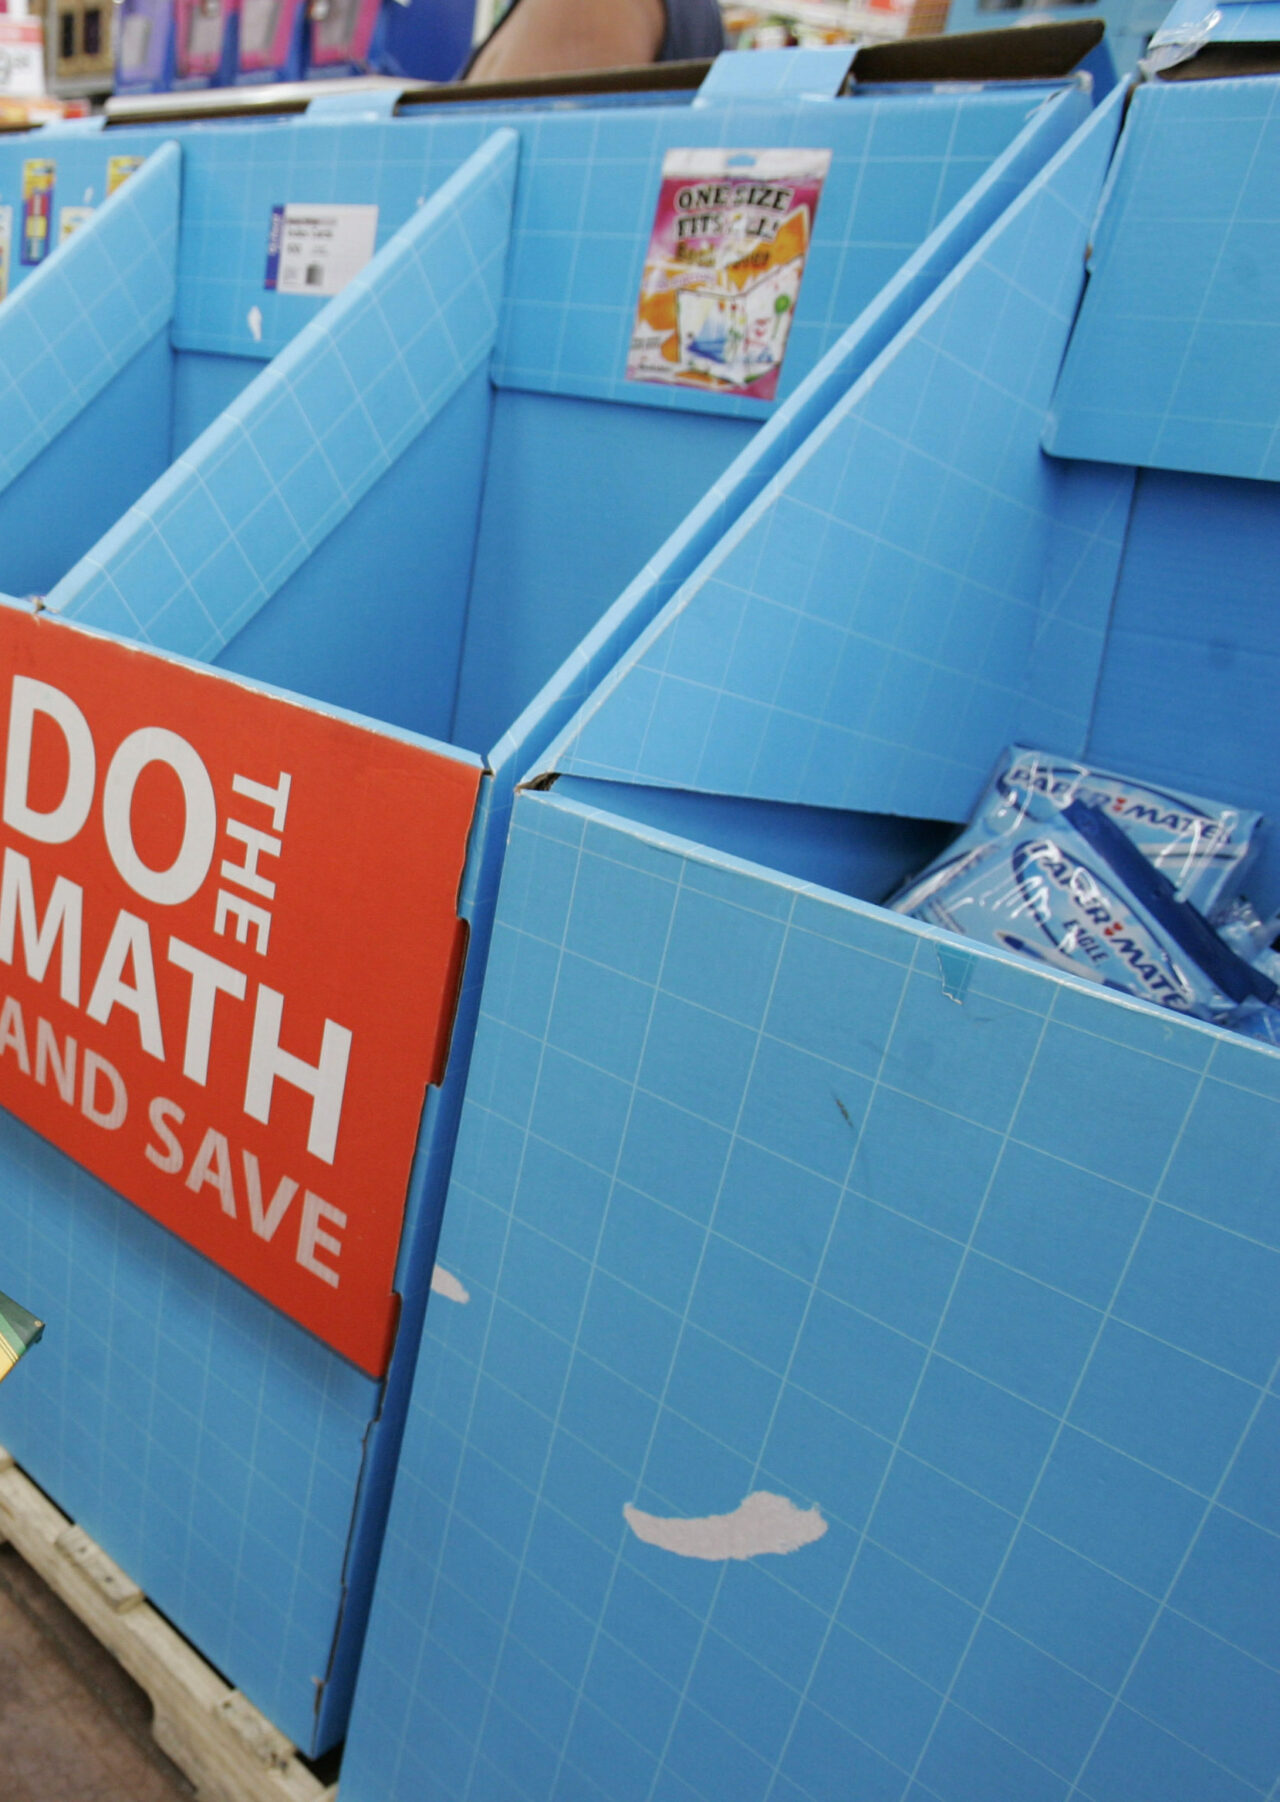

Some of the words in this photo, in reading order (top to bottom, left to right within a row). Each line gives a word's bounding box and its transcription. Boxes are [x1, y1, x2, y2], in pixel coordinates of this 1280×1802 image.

[2, 674, 217, 905] DO
[213, 771, 292, 957] THE
[144, 1096, 348, 1289] SAVE
